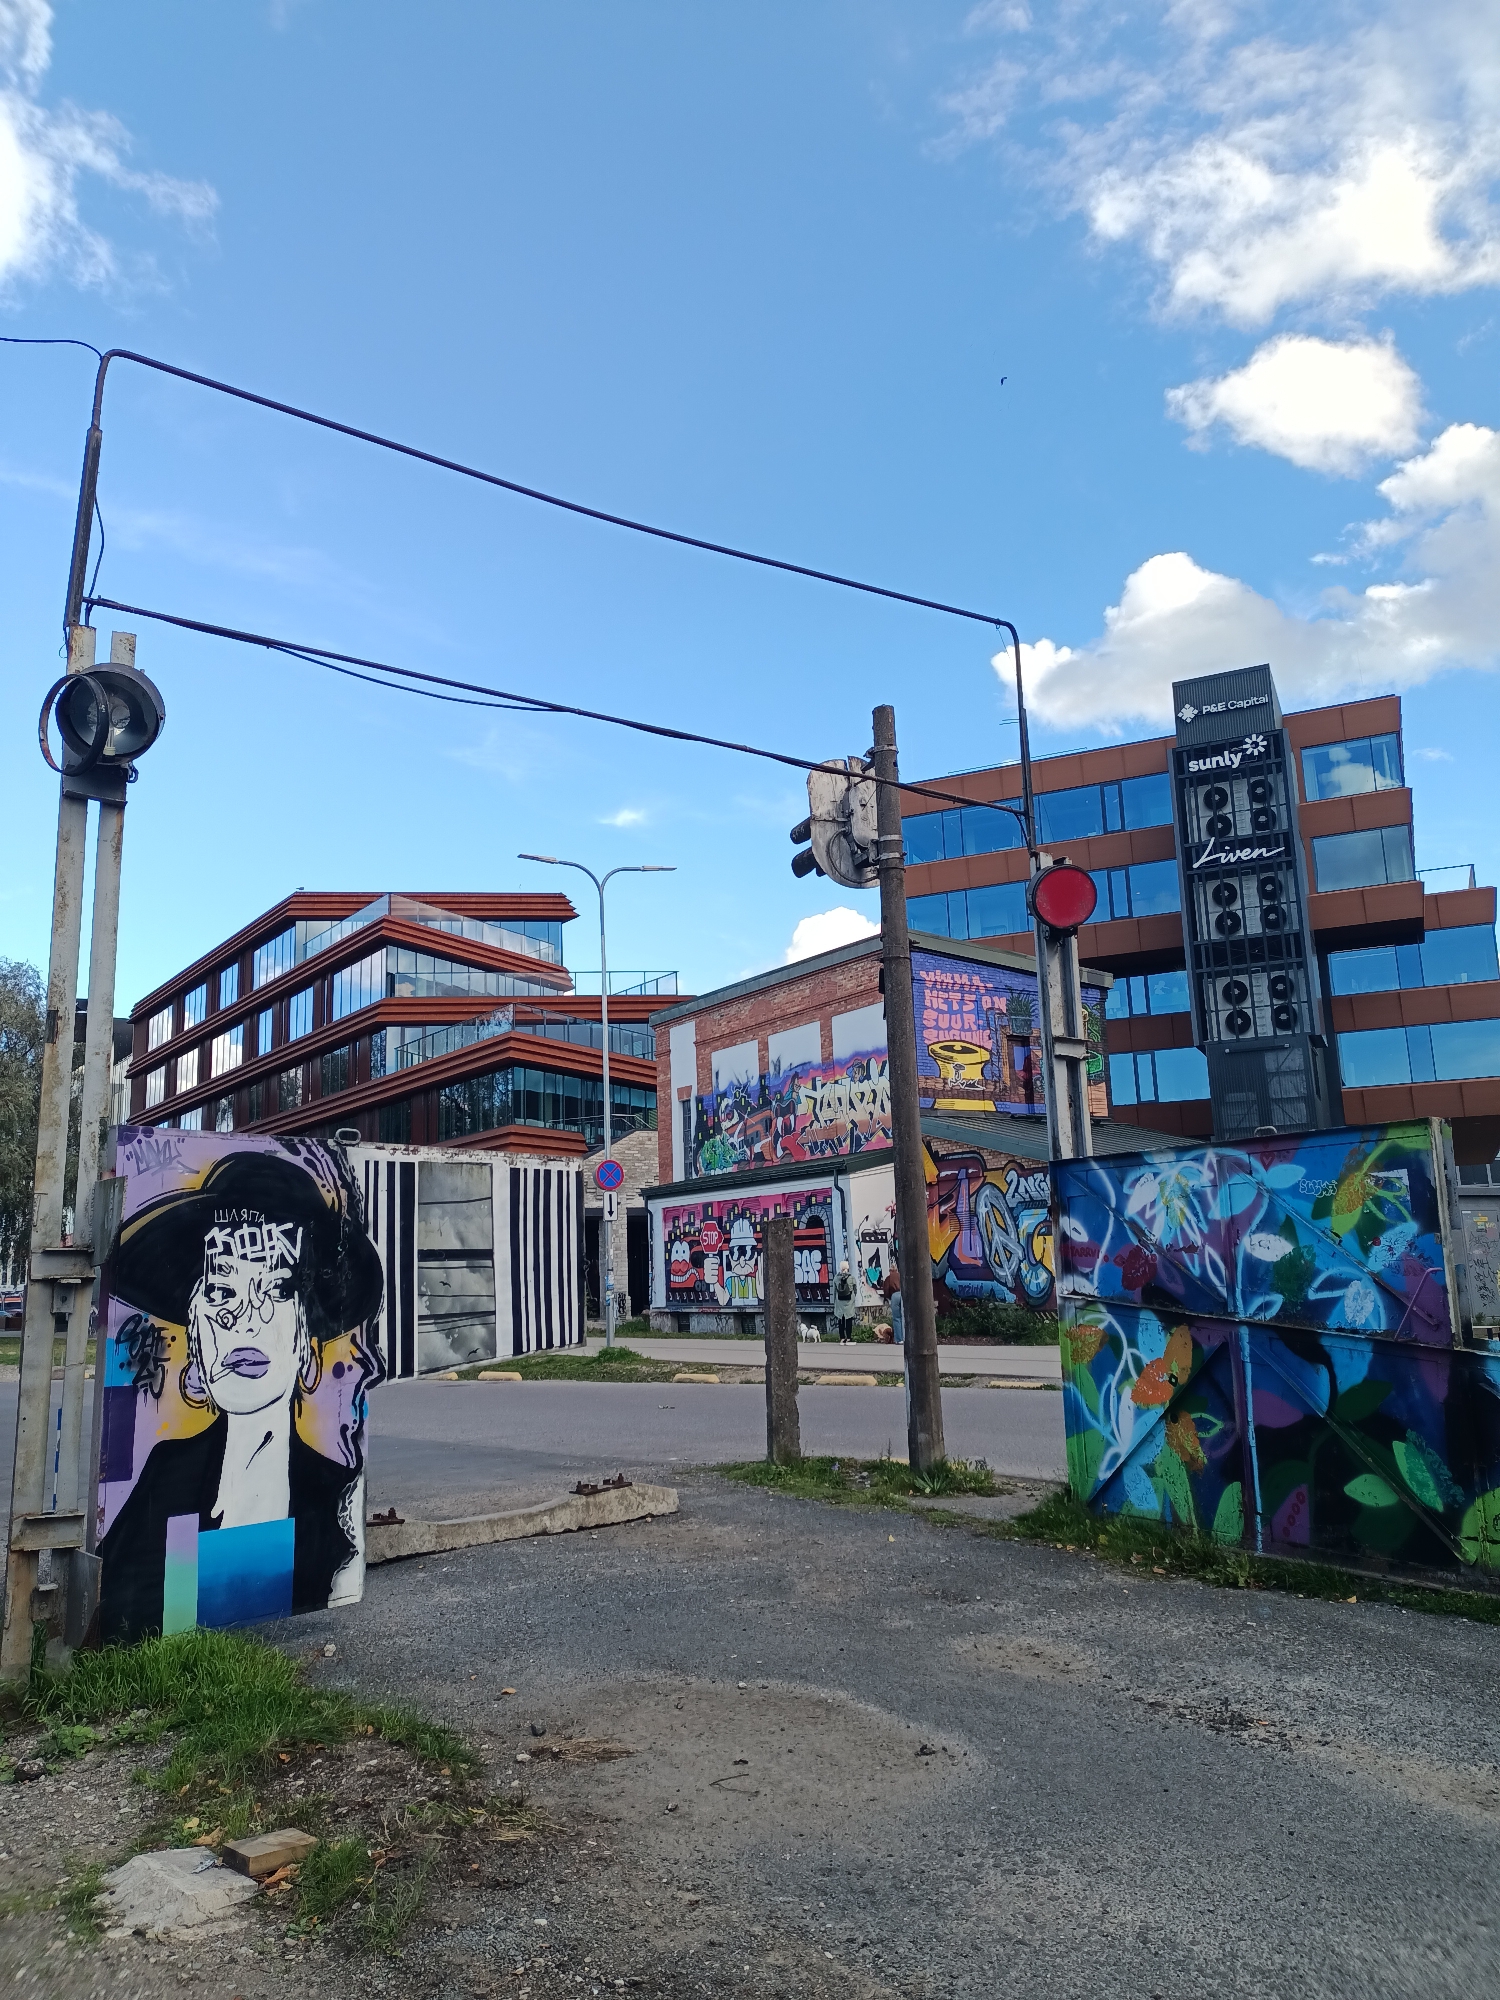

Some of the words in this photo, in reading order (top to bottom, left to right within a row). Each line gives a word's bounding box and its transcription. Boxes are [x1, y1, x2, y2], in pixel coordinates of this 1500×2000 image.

[1202, 702, 1227, 715] P&E
[1228, 693, 1269, 709] Capital
[1188, 750, 1243, 773] sunly
[1192, 836, 1286, 869] Liven
[214, 1208, 266, 1224] ШЛЯПА
[702, 1231, 719, 1246] STOP
